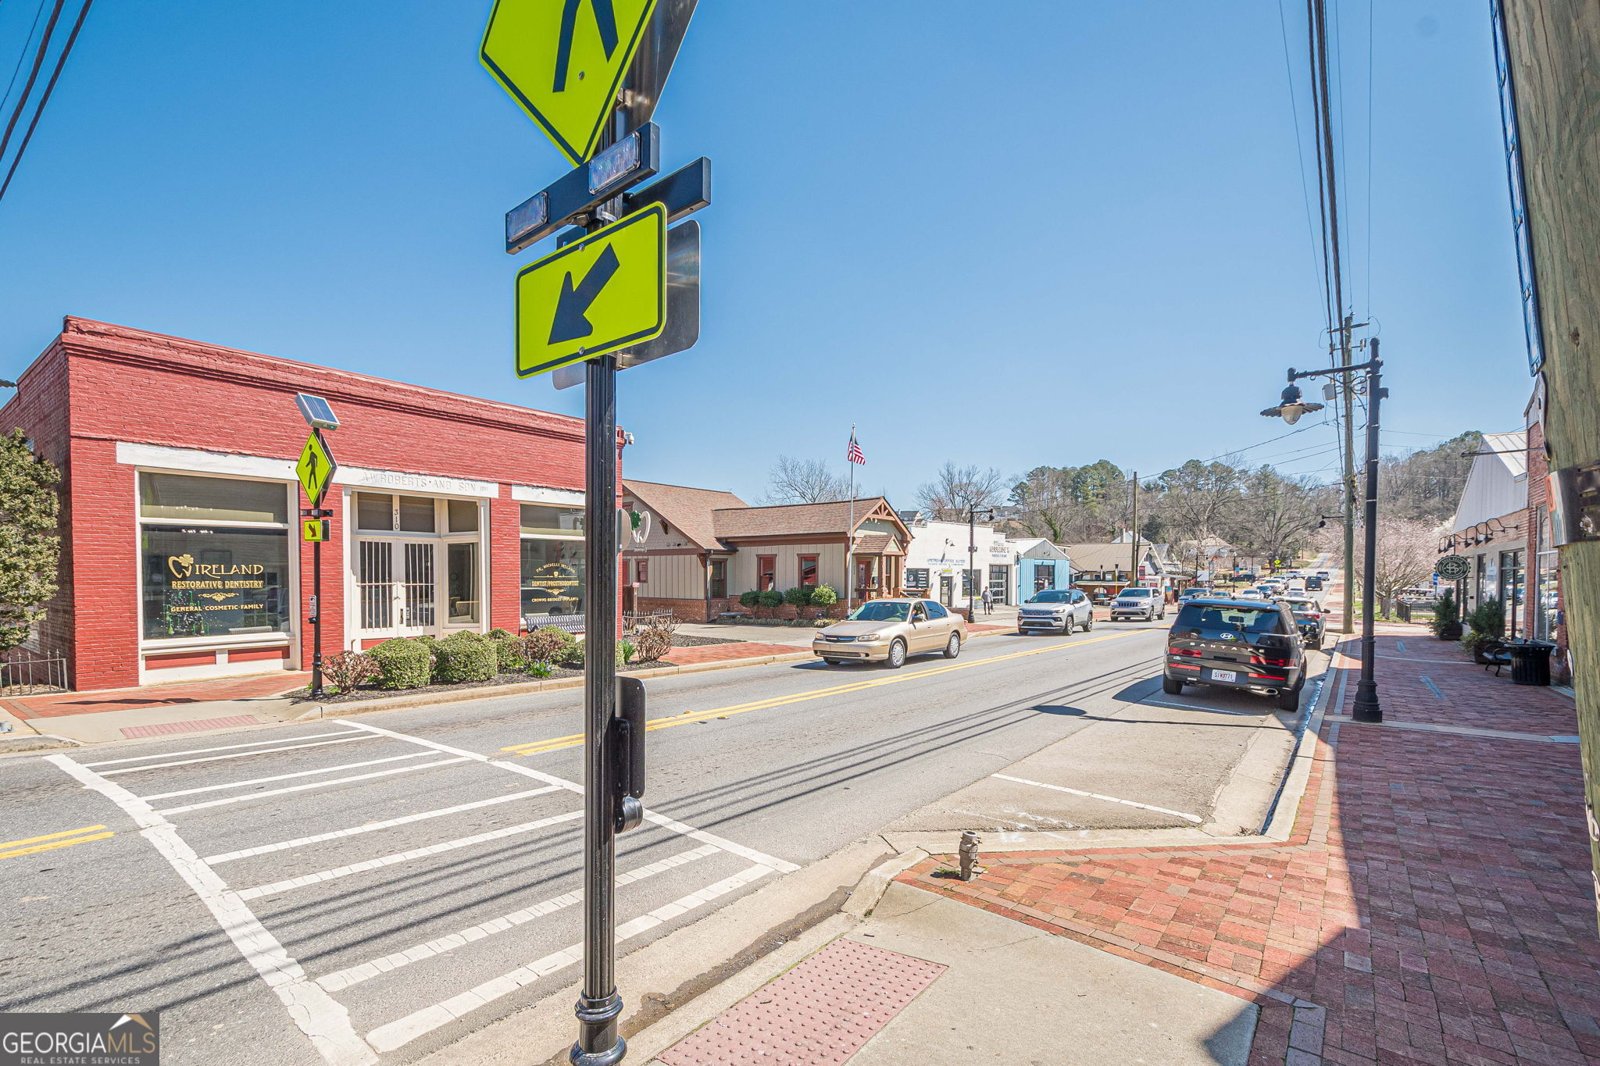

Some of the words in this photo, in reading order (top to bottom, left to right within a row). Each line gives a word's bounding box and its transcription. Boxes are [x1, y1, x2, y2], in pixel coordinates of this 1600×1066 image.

[195, 564, 264, 578] IRELAND
[172, 581, 223, 589] RESTORATIVE
[225, 581, 263, 589] DENTISTRY
